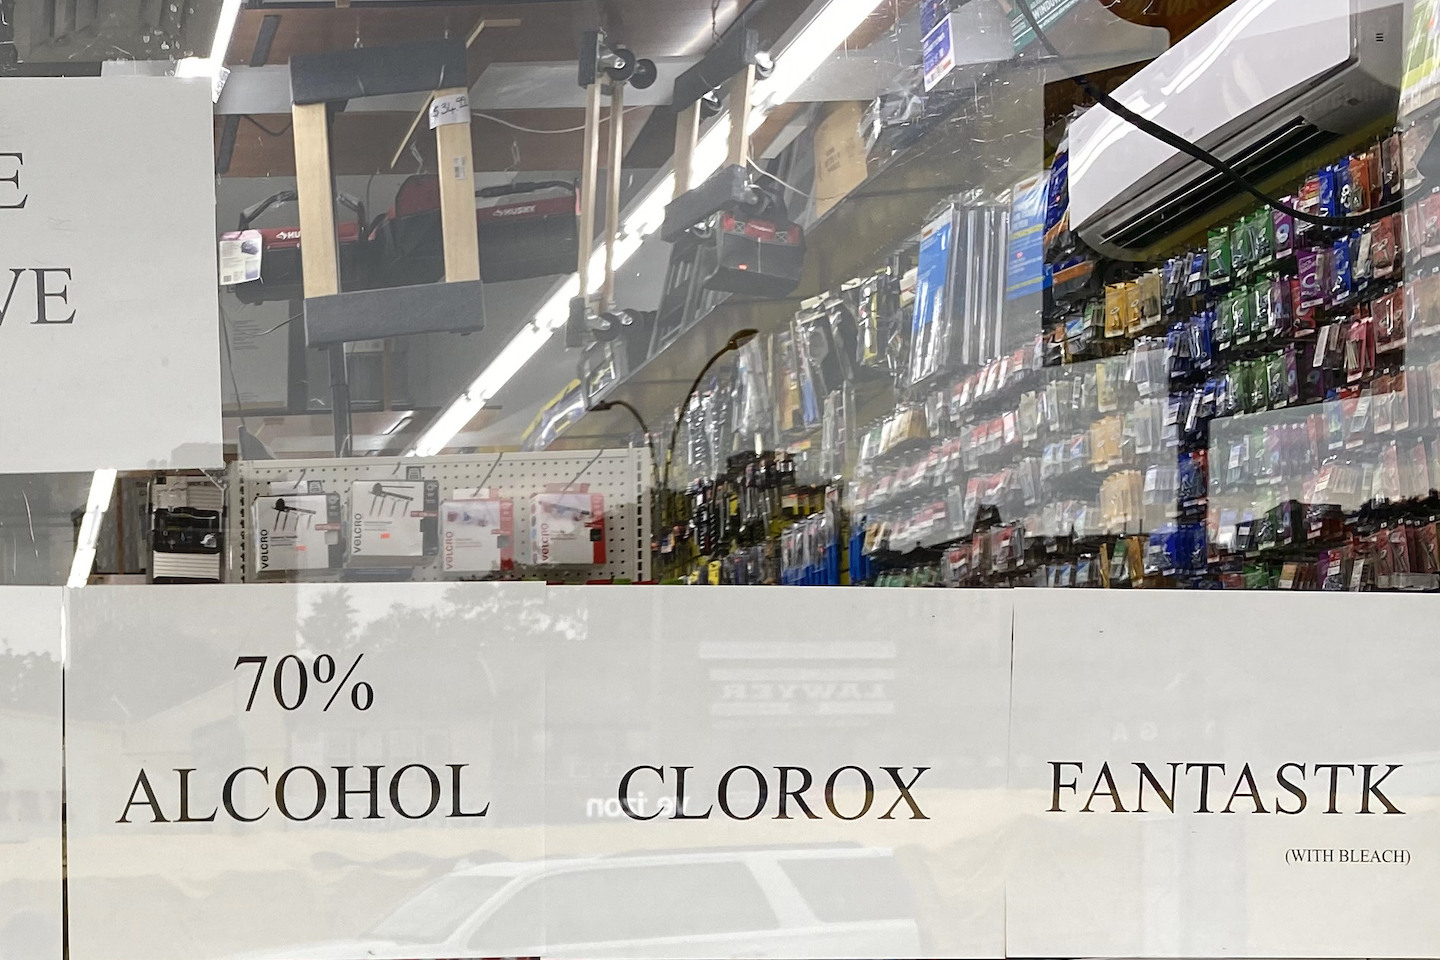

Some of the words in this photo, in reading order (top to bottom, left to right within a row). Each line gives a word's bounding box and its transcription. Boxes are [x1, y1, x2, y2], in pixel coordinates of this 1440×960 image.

[233, 654, 375, 712] 70%
[115, 763, 490, 824] ALCOHOL
[618, 765, 931, 821] CLOROX
[1045, 761, 1406, 815] FANTASTK
[1285, 847, 1335, 867] (WITH
[1338, 847, 1411, 867] BLEACH)
